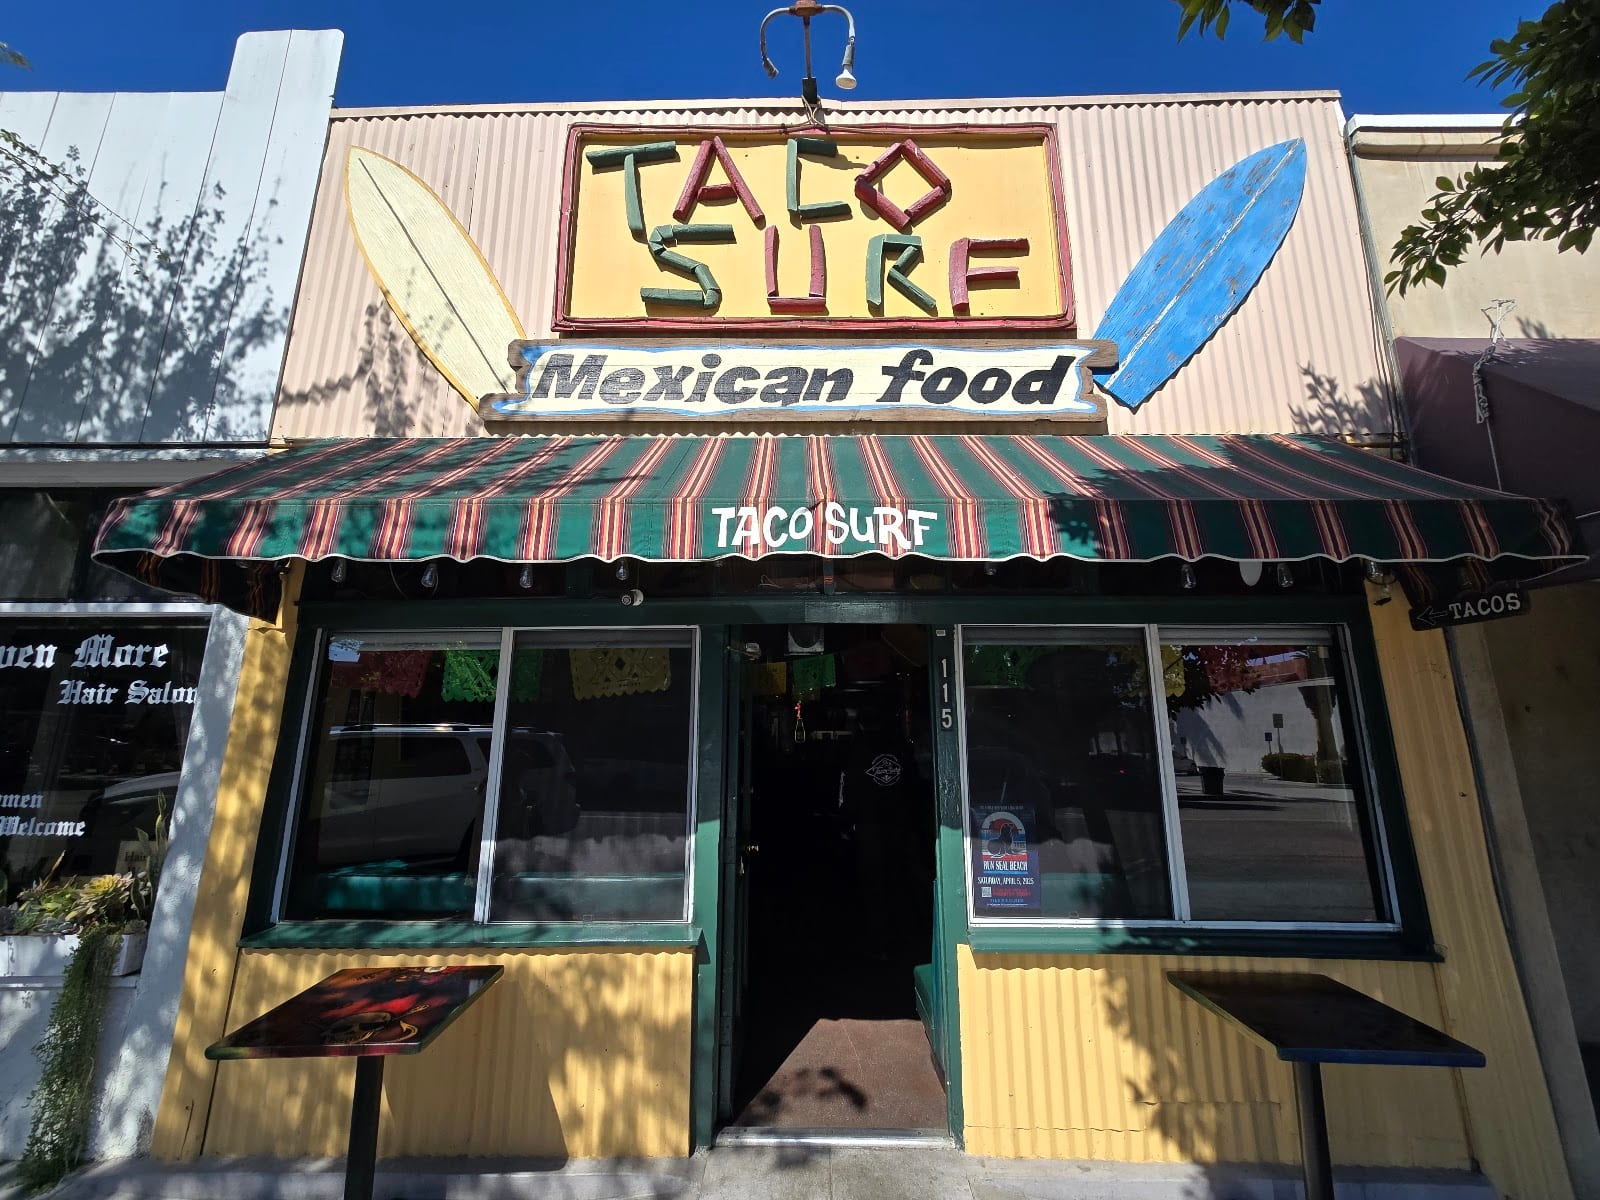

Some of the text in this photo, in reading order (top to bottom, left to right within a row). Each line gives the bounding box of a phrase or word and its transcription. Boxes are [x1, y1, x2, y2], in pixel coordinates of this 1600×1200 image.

[586, 136, 952, 235] TACO
[640, 224, 1030, 314] SURF
[532, 349, 1078, 406] Mexican food
[711, 506, 814, 548] TACO
[1448, 592, 1521, 619] TACOS
[71, 634, 169, 669] More
[57, 679, 199, 705] Hair Salon
[941, 658, 953, 729] 115
[0, 815, 86, 837] Welcome
[977, 876, 1002, 885] SATURDAY,
[1003, 877, 1016, 885] APRIL
[983, 861, 1027, 870] RUN SEAL BEACH
